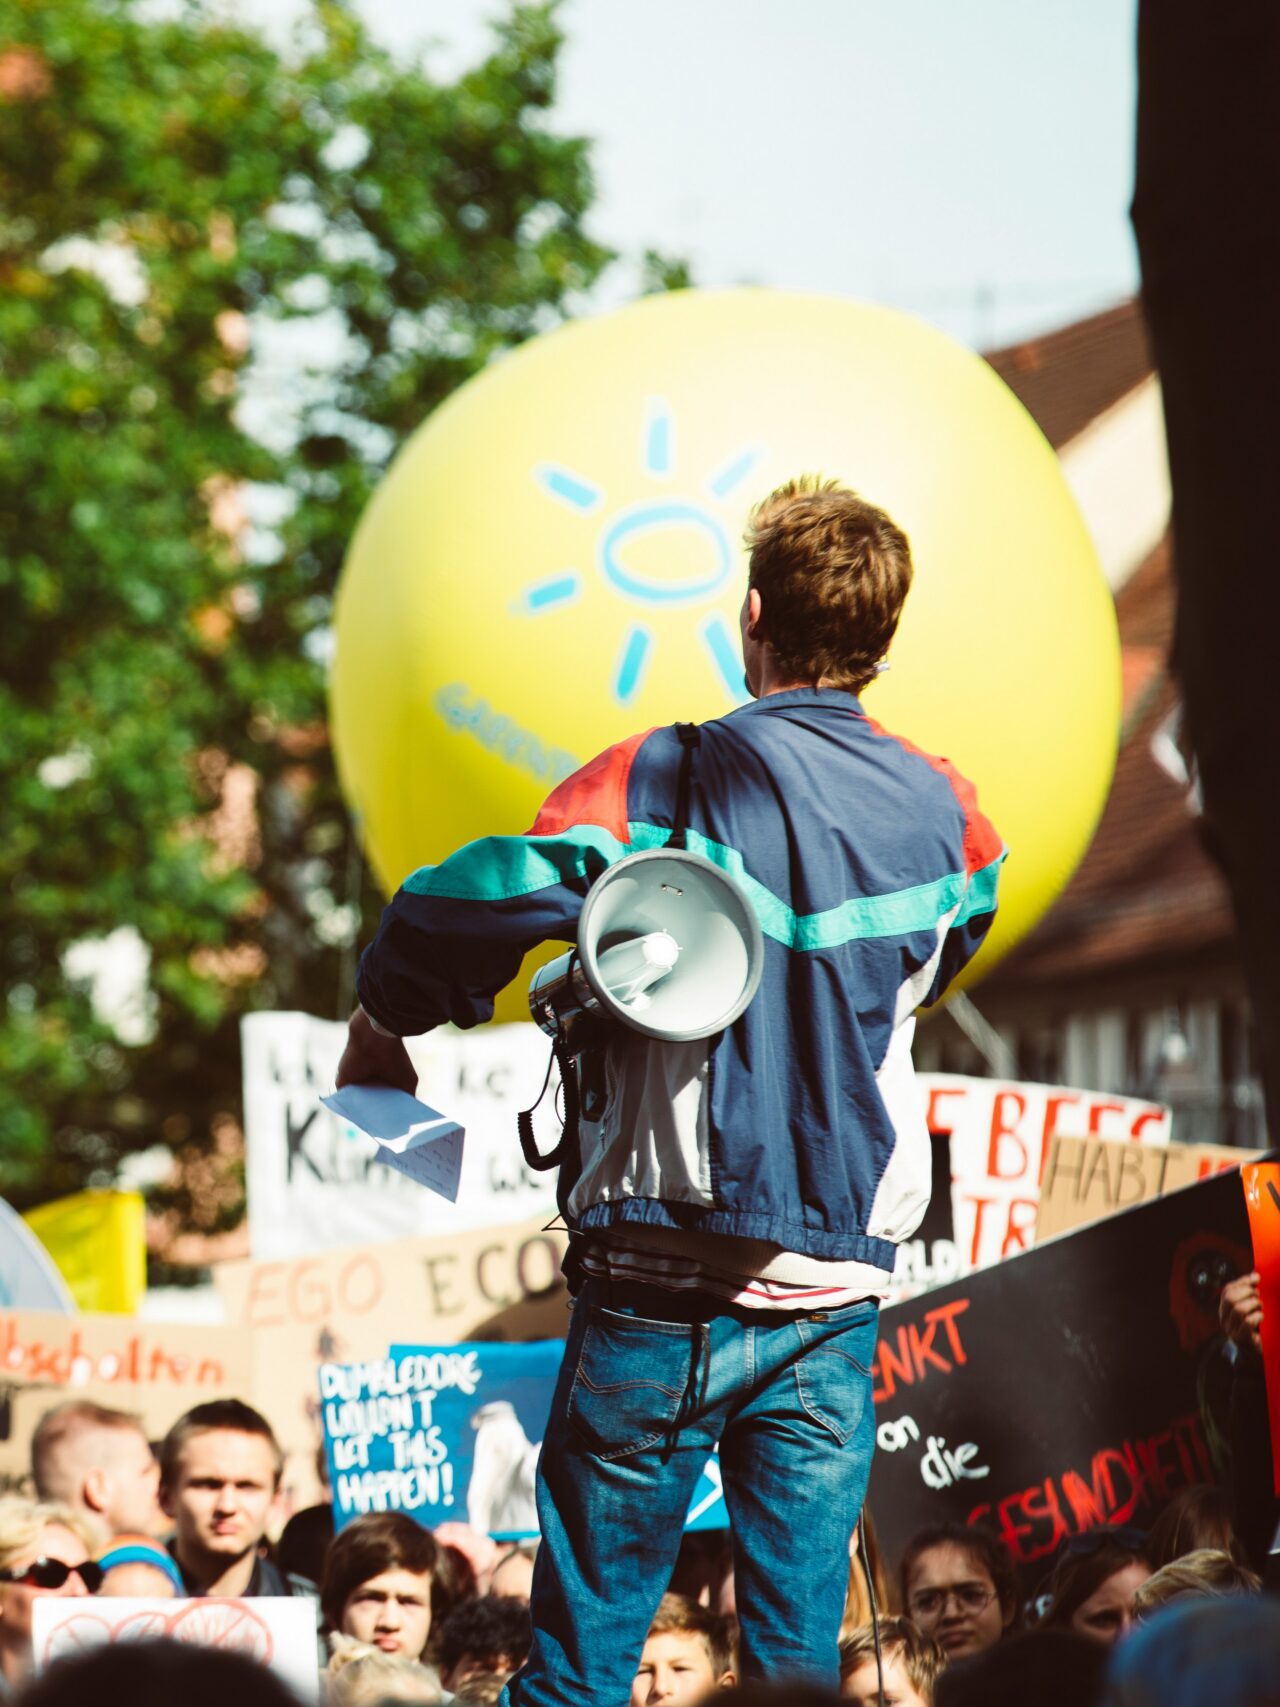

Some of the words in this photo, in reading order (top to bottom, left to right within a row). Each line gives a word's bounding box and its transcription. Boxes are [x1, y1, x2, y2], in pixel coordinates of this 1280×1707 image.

[244, 1252, 384, 1328] EGO
[333, 1431, 374, 1470] LET
[388, 1426, 448, 1470] THIS
[921, 1435, 990, 1490] die
[337, 1462, 456, 1514] HAPPEN!
